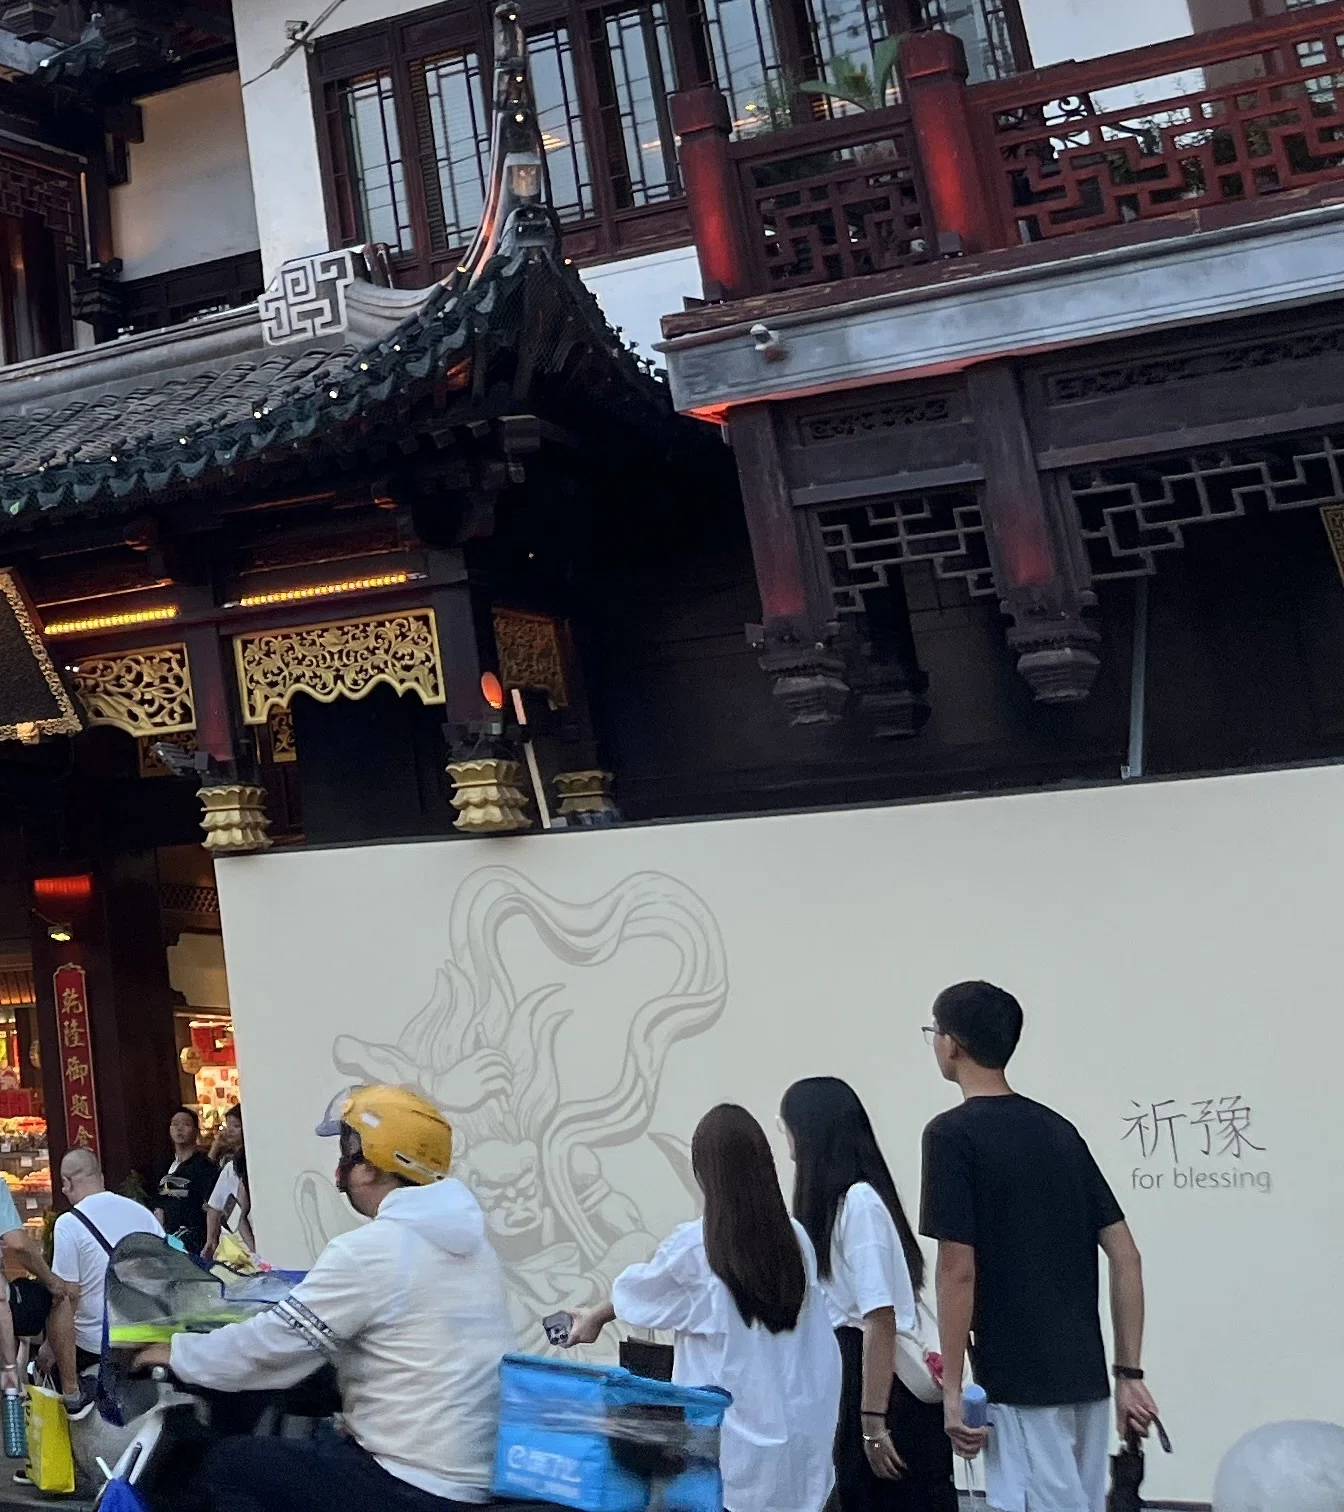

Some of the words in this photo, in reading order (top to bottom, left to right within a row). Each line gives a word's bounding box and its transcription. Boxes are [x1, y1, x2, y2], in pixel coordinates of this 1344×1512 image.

[1120, 1095, 1267, 1164] 祈豫
[1132, 1167, 1164, 1190] for
[1174, 1166, 1272, 1194] blessing
